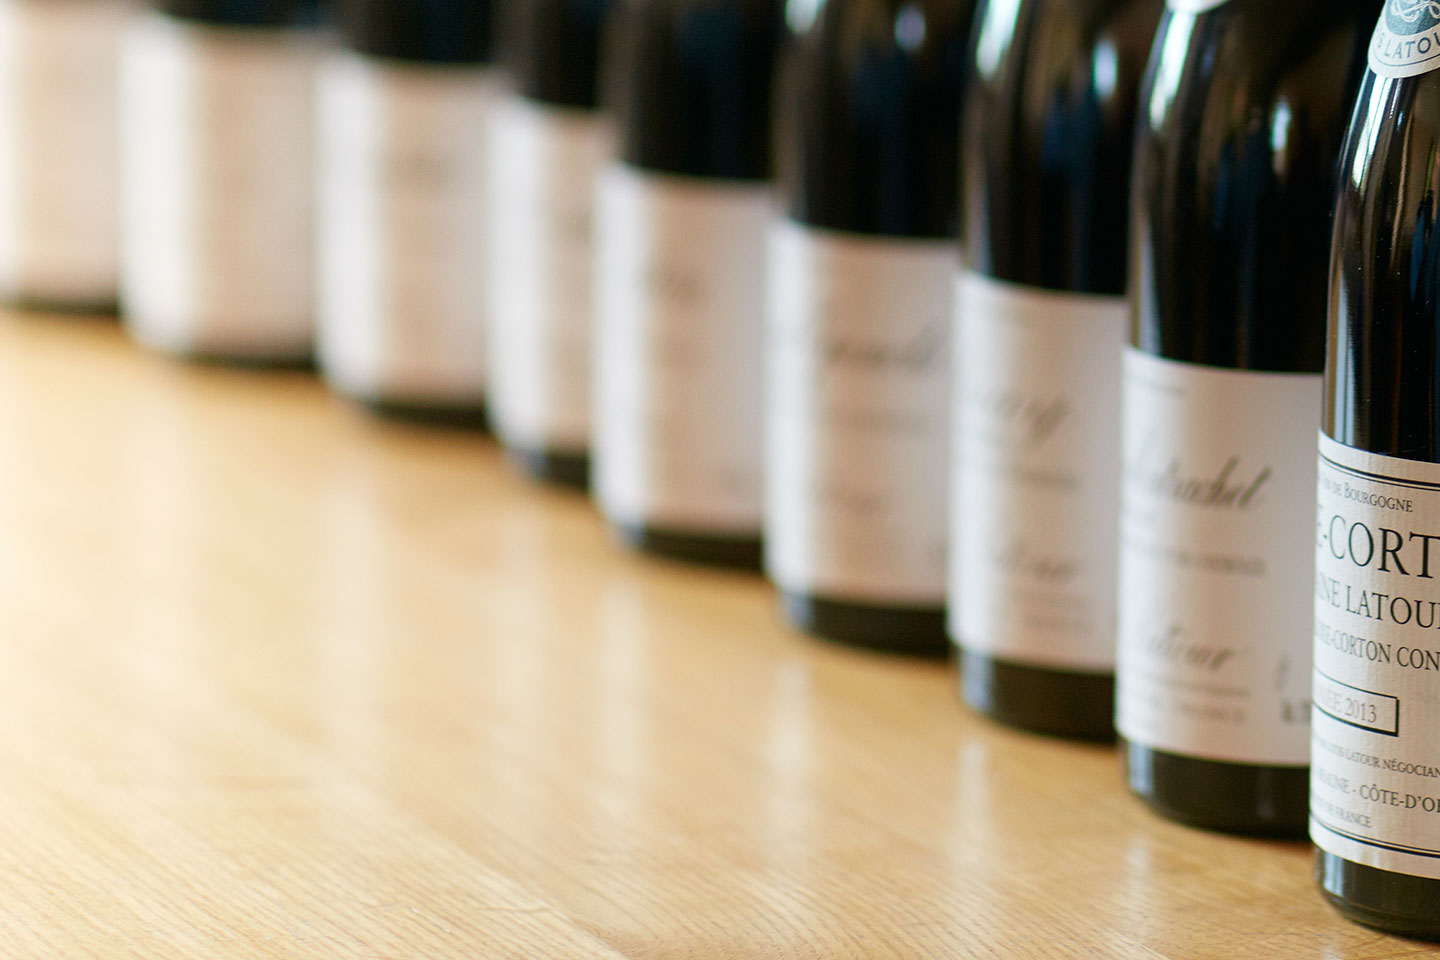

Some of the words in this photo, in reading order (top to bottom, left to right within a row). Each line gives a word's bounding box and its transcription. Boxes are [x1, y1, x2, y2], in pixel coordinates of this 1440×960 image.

[1344, 481, 1414, 513] BOURGOGNE
[1315, 620, 1392, 664] E-CORTON
[1345, 697, 1378, 723] 2013
